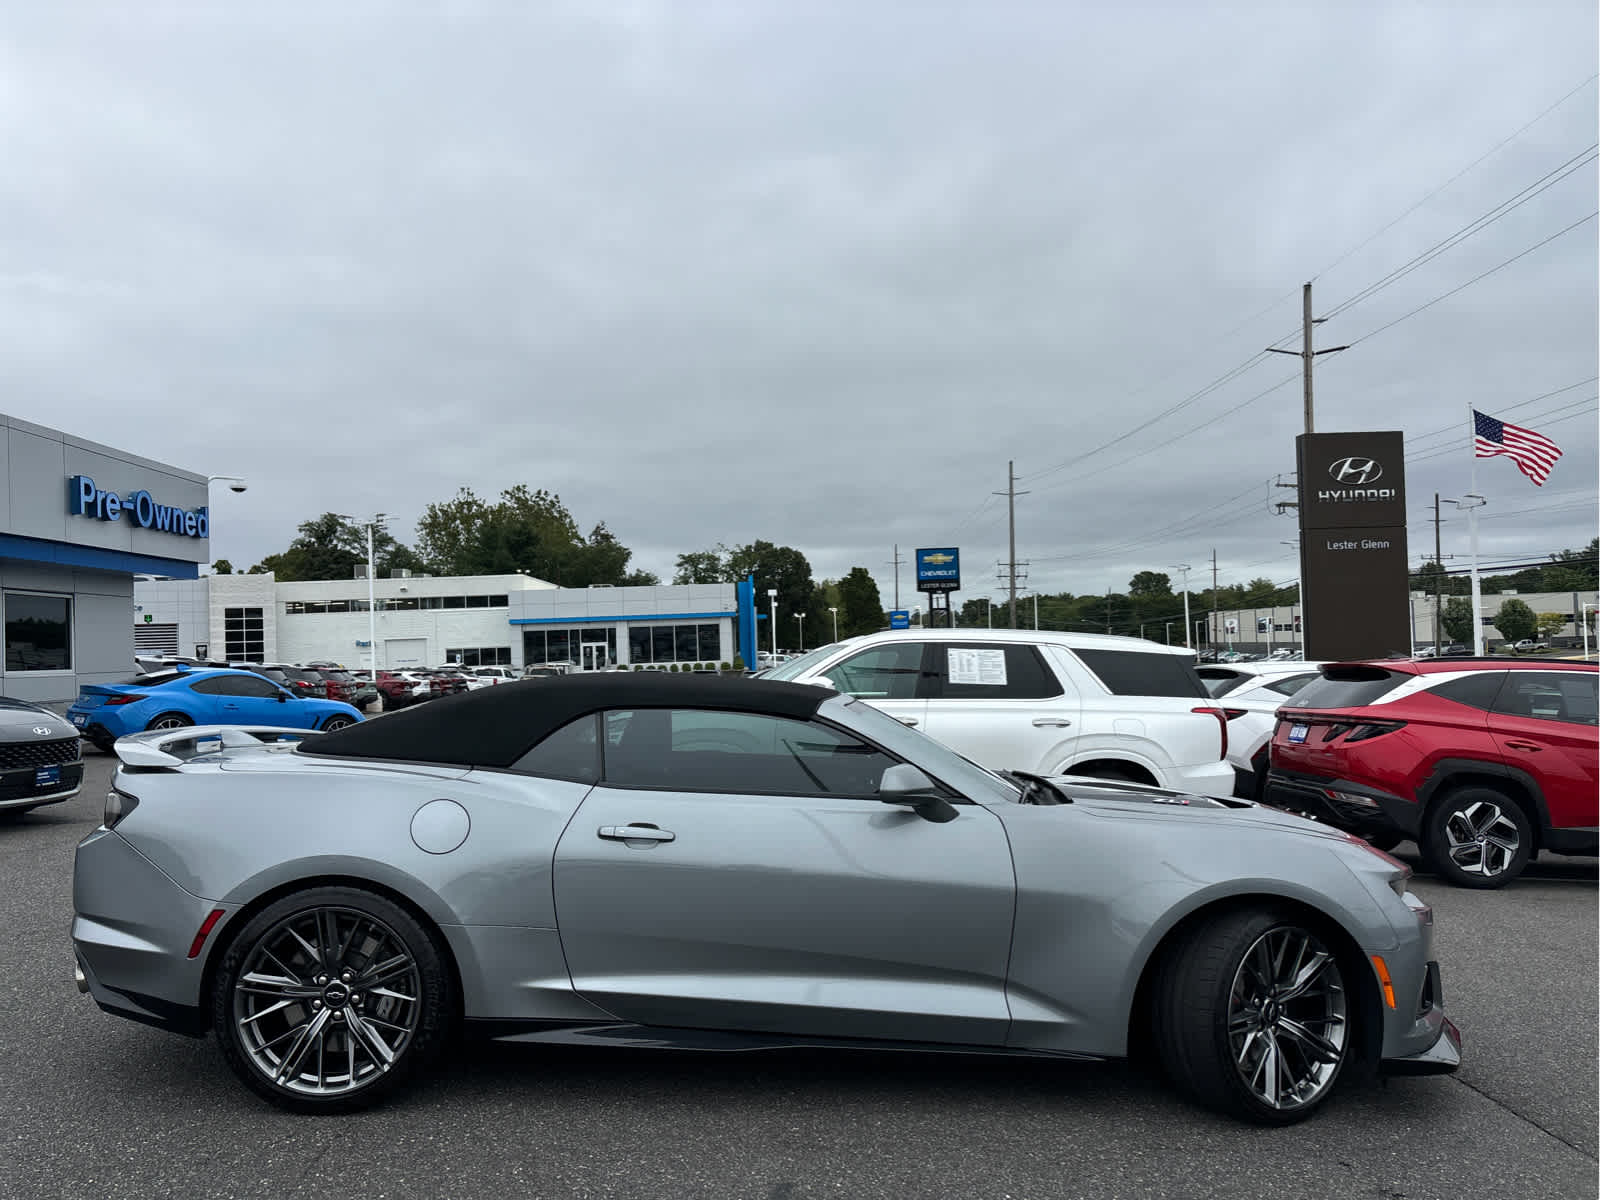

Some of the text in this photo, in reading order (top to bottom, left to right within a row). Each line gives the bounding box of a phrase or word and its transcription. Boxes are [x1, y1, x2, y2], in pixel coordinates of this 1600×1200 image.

[1318, 489, 1396, 502] HYUNDAI
[71, 475, 209, 538] Pre-Owned
[1327, 539, 1390, 550] Lester Glenn
